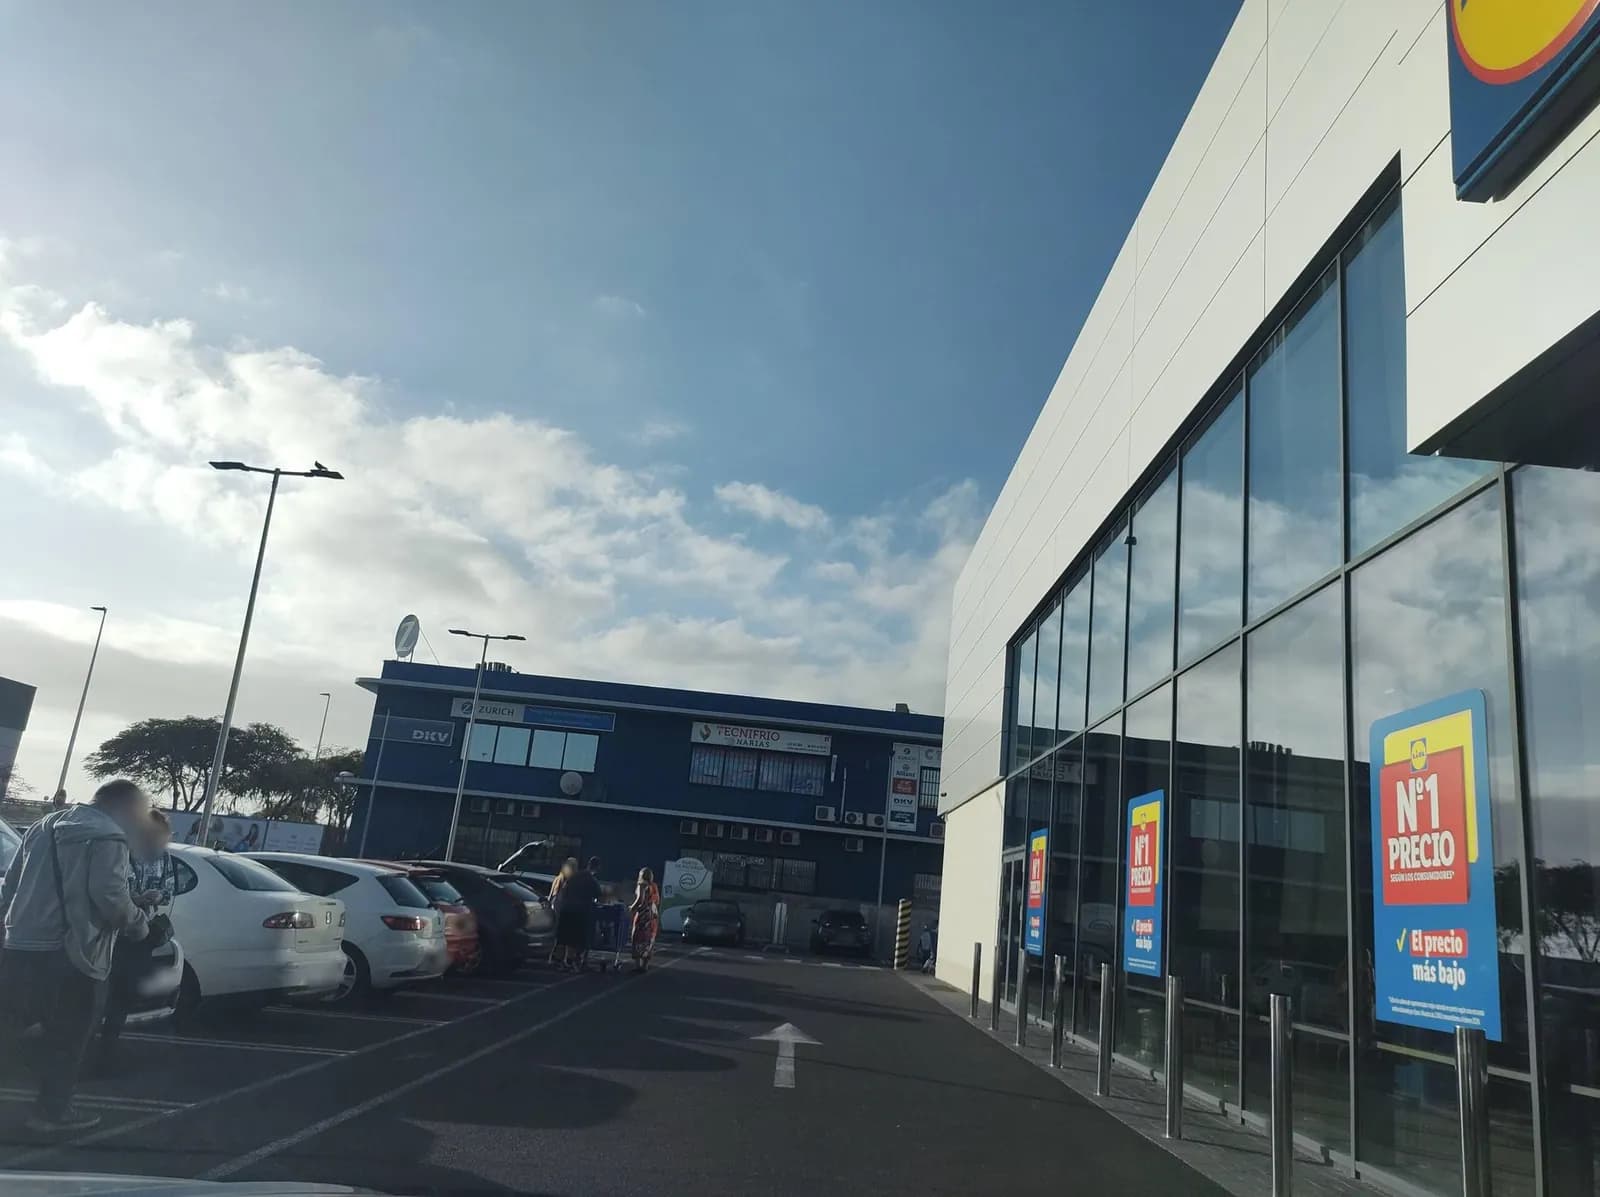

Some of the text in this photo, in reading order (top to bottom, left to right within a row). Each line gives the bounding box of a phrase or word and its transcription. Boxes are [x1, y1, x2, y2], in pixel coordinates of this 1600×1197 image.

[478, 704, 515, 717] ZURICH
[411, 729, 450, 743] DKV
[717, 725, 780, 742] TECNIFRIO
[1387, 830, 1455, 870] PRECIO
[1131, 866, 1152, 887] PRECIO
[1411, 929, 1463, 957] El precio
[1412, 960, 1466, 991] más bajo
